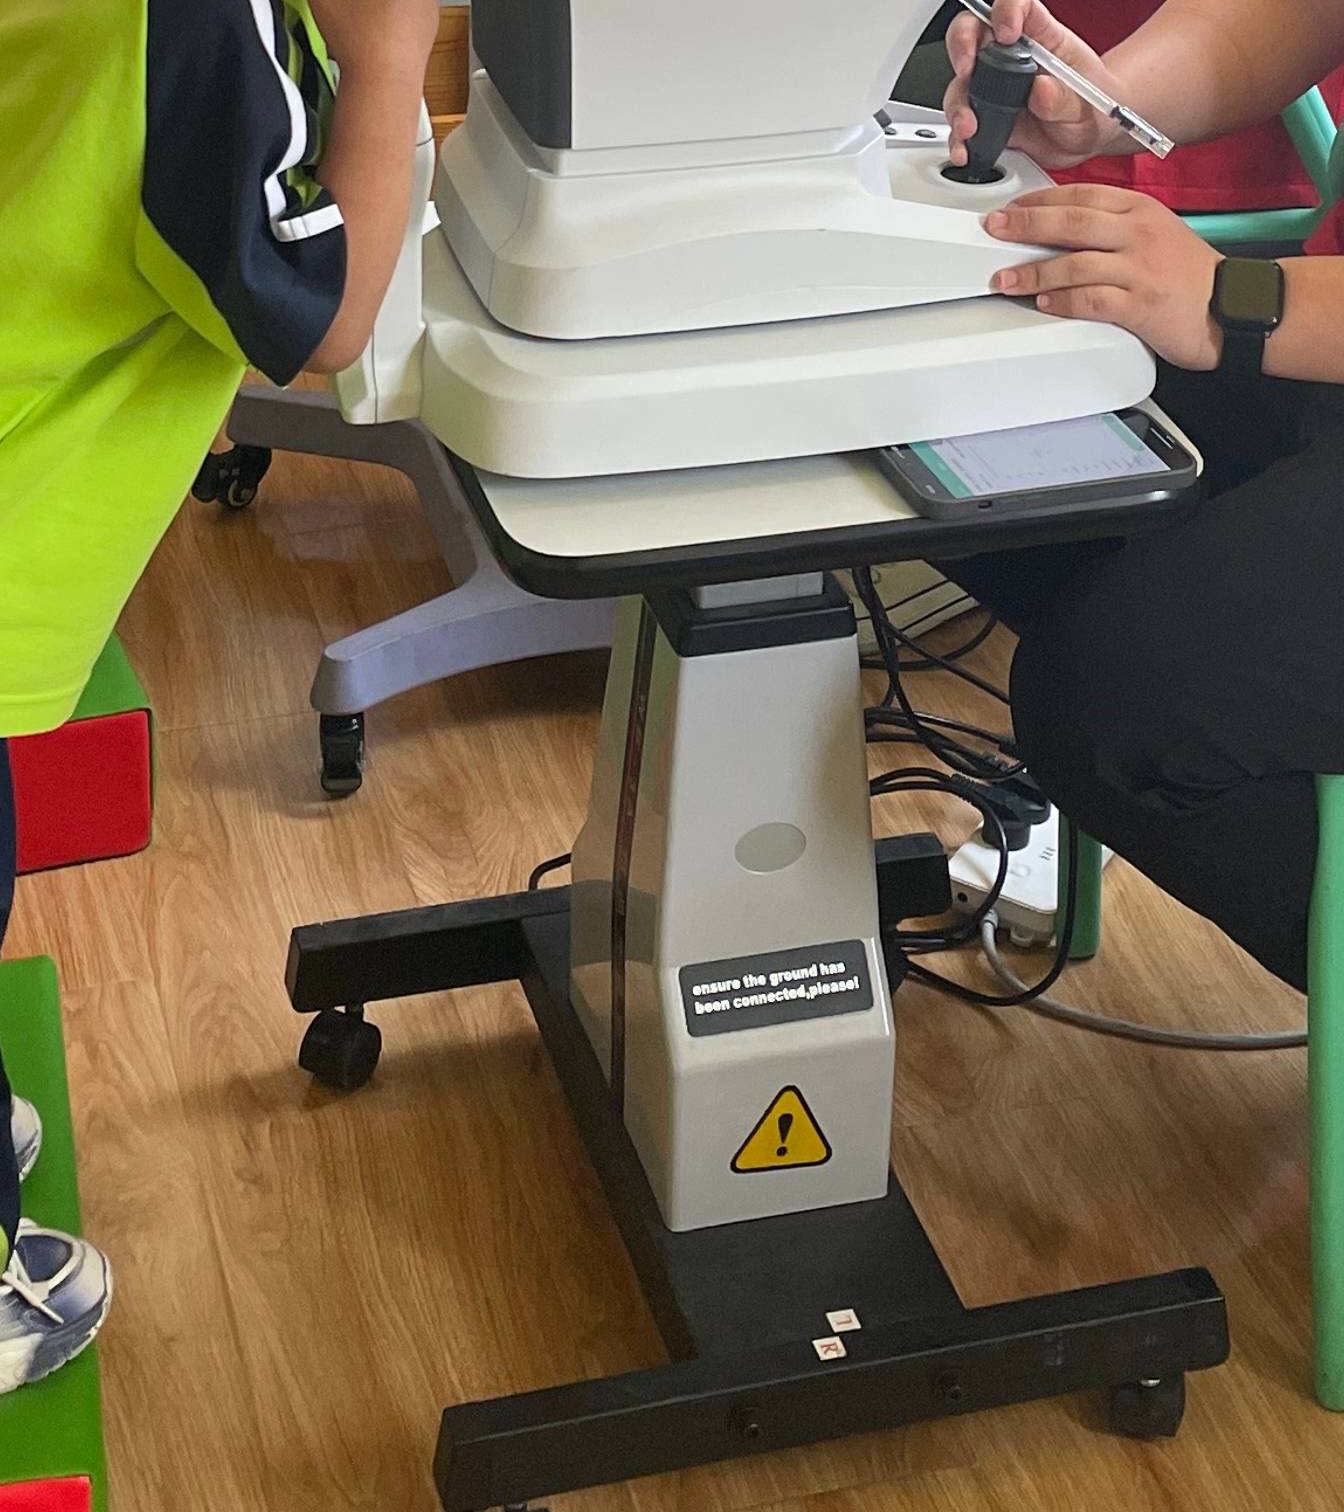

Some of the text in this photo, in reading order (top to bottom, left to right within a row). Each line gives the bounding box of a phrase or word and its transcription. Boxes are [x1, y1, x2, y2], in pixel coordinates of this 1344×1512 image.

[692, 961, 846, 996] ensure the ground has
[694, 999, 731, 1016] been
